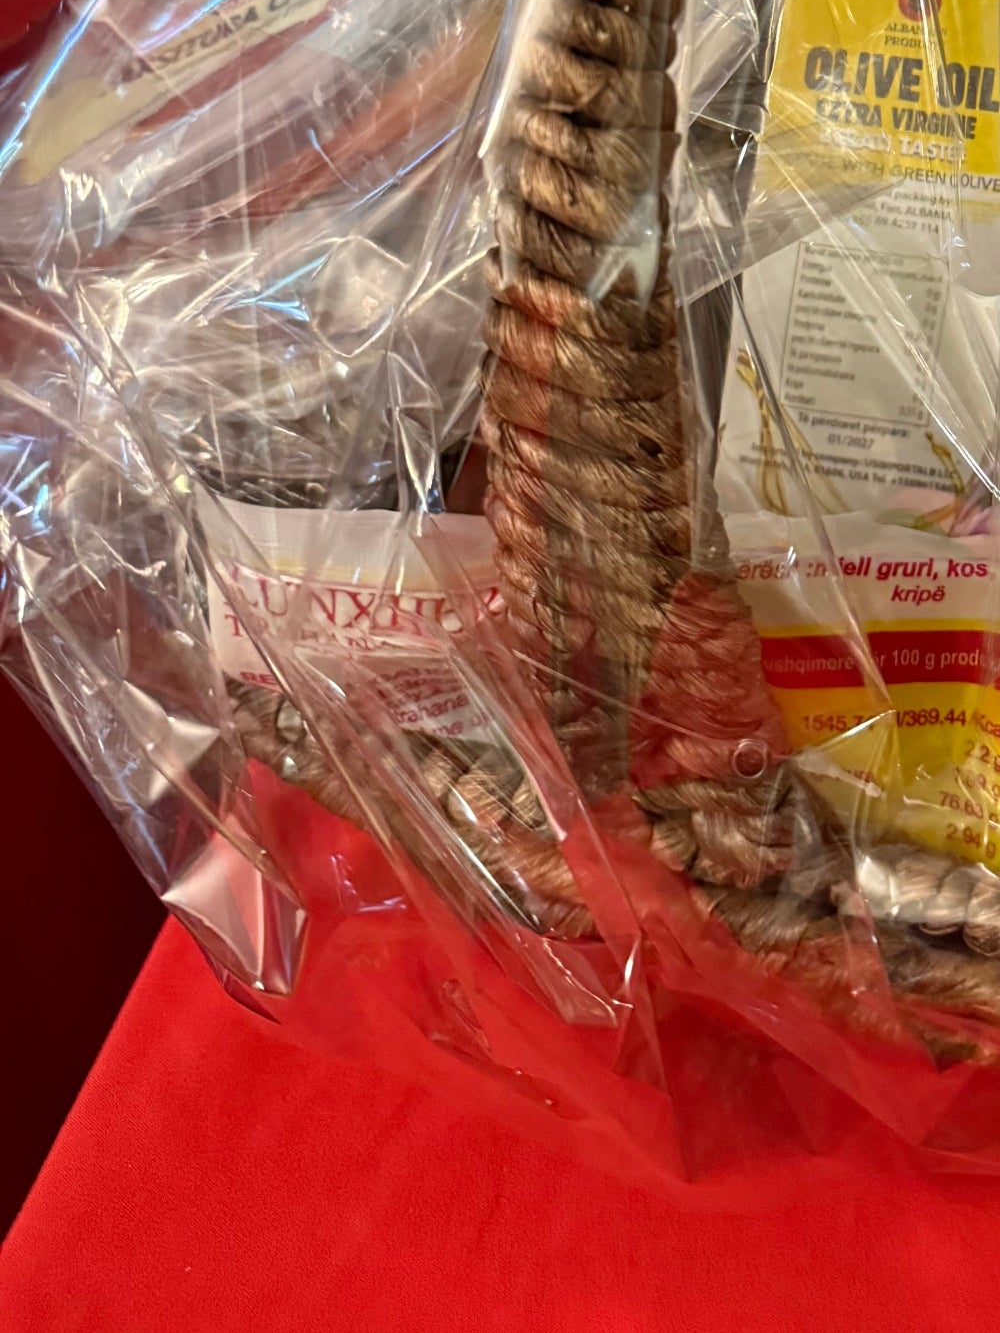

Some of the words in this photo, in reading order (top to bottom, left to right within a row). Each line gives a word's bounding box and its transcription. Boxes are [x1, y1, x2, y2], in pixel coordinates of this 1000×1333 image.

[803, 46, 924, 103] OLIVE
[936, 61, 1000, 113] OIL
[889, 165, 947, 185] GREEN
[890, 584, 946, 606] kripë
[892, 649, 919, 666] 100
[925, 652, 935, 670] g
